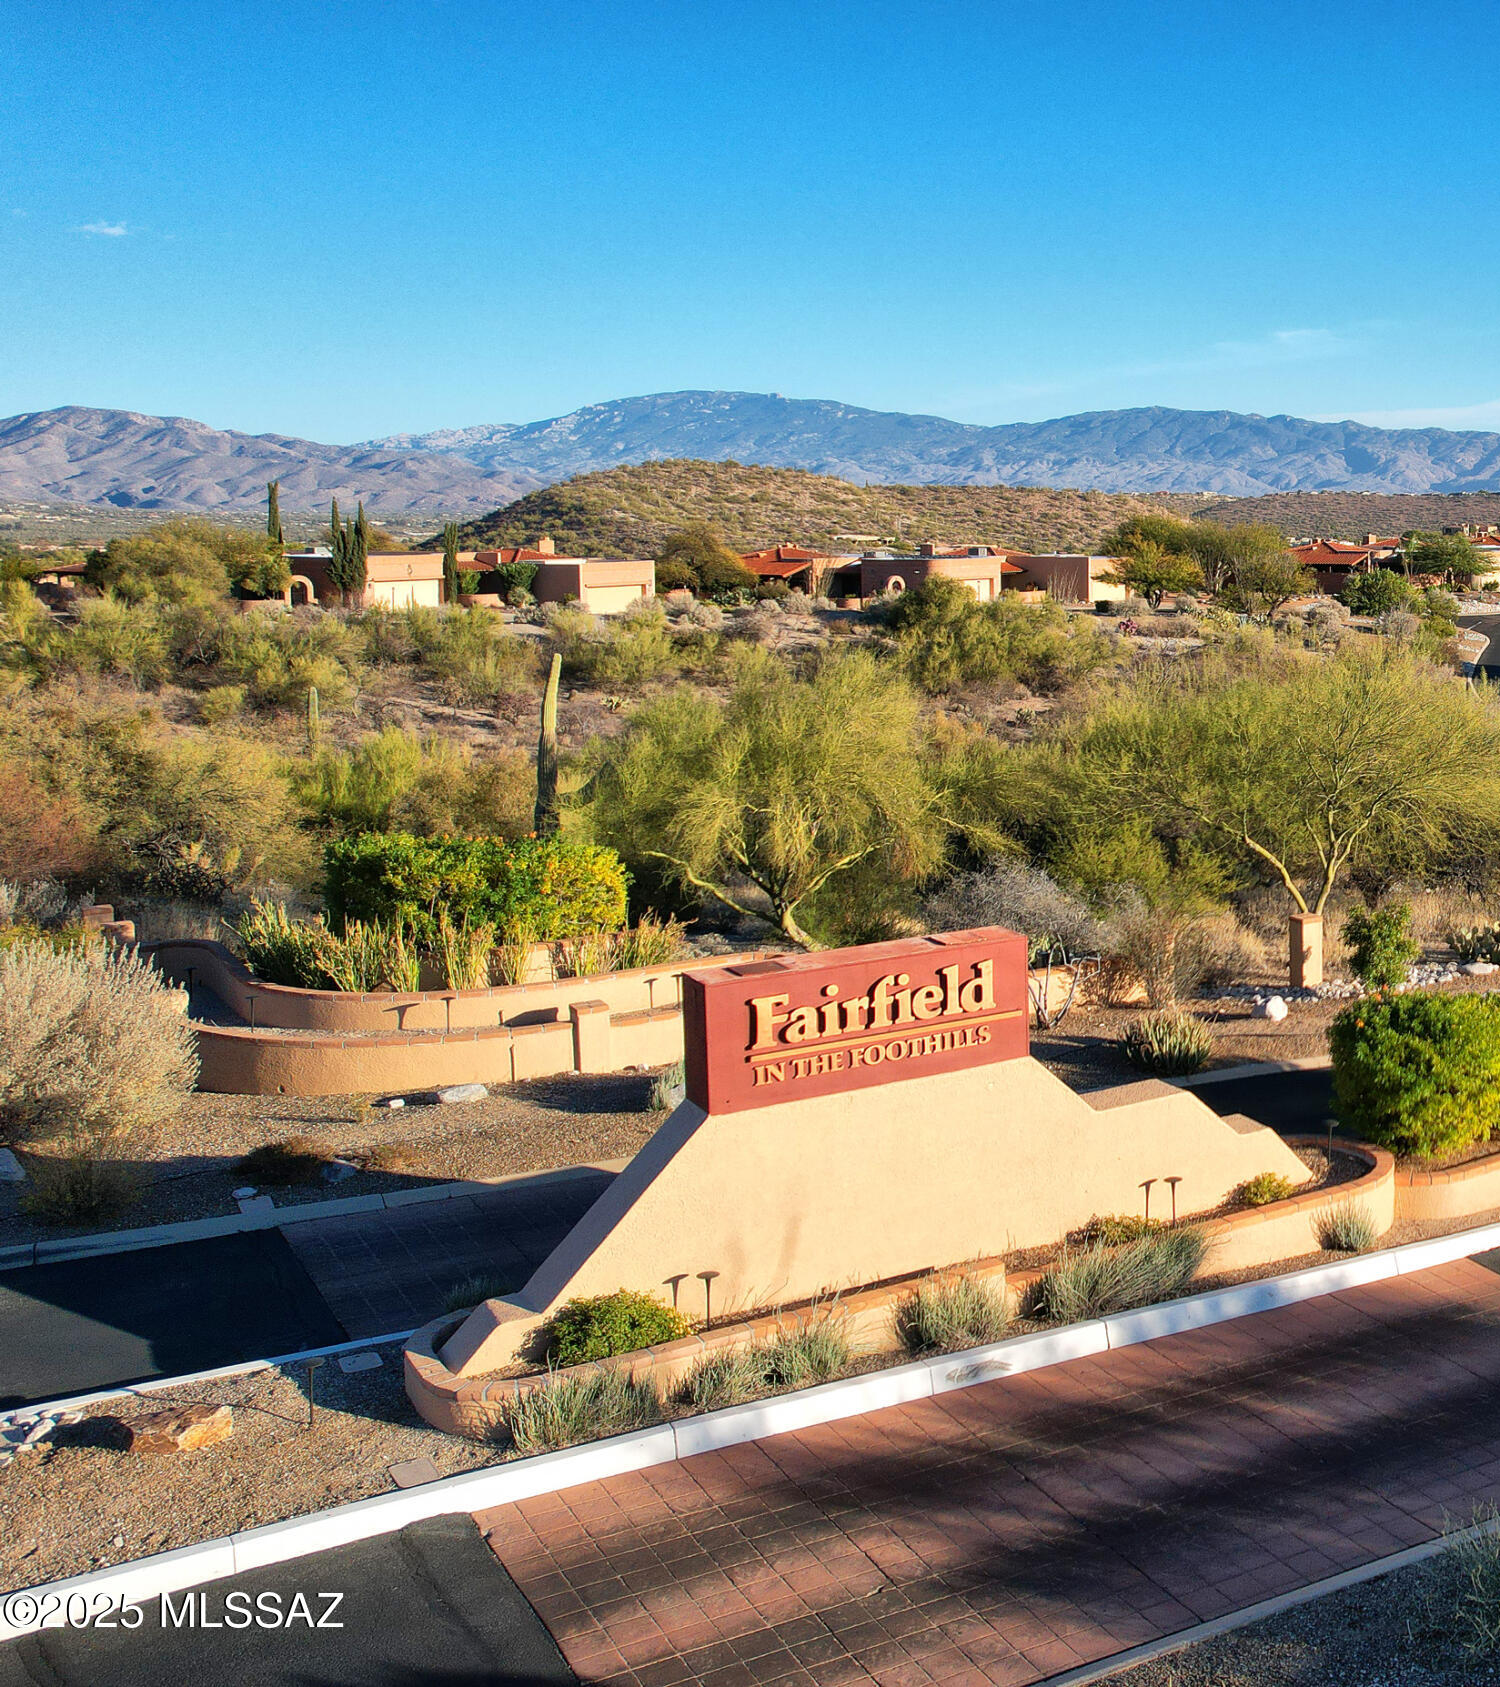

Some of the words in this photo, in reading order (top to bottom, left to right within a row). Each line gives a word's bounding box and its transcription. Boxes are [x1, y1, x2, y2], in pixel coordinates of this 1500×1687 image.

[751, 959, 997, 1050] Fairfield
[754, 1063, 786, 1086] IN
[793, 1051, 844, 1080] THE
[851, 1025, 992, 1068] FOOTHILLS
